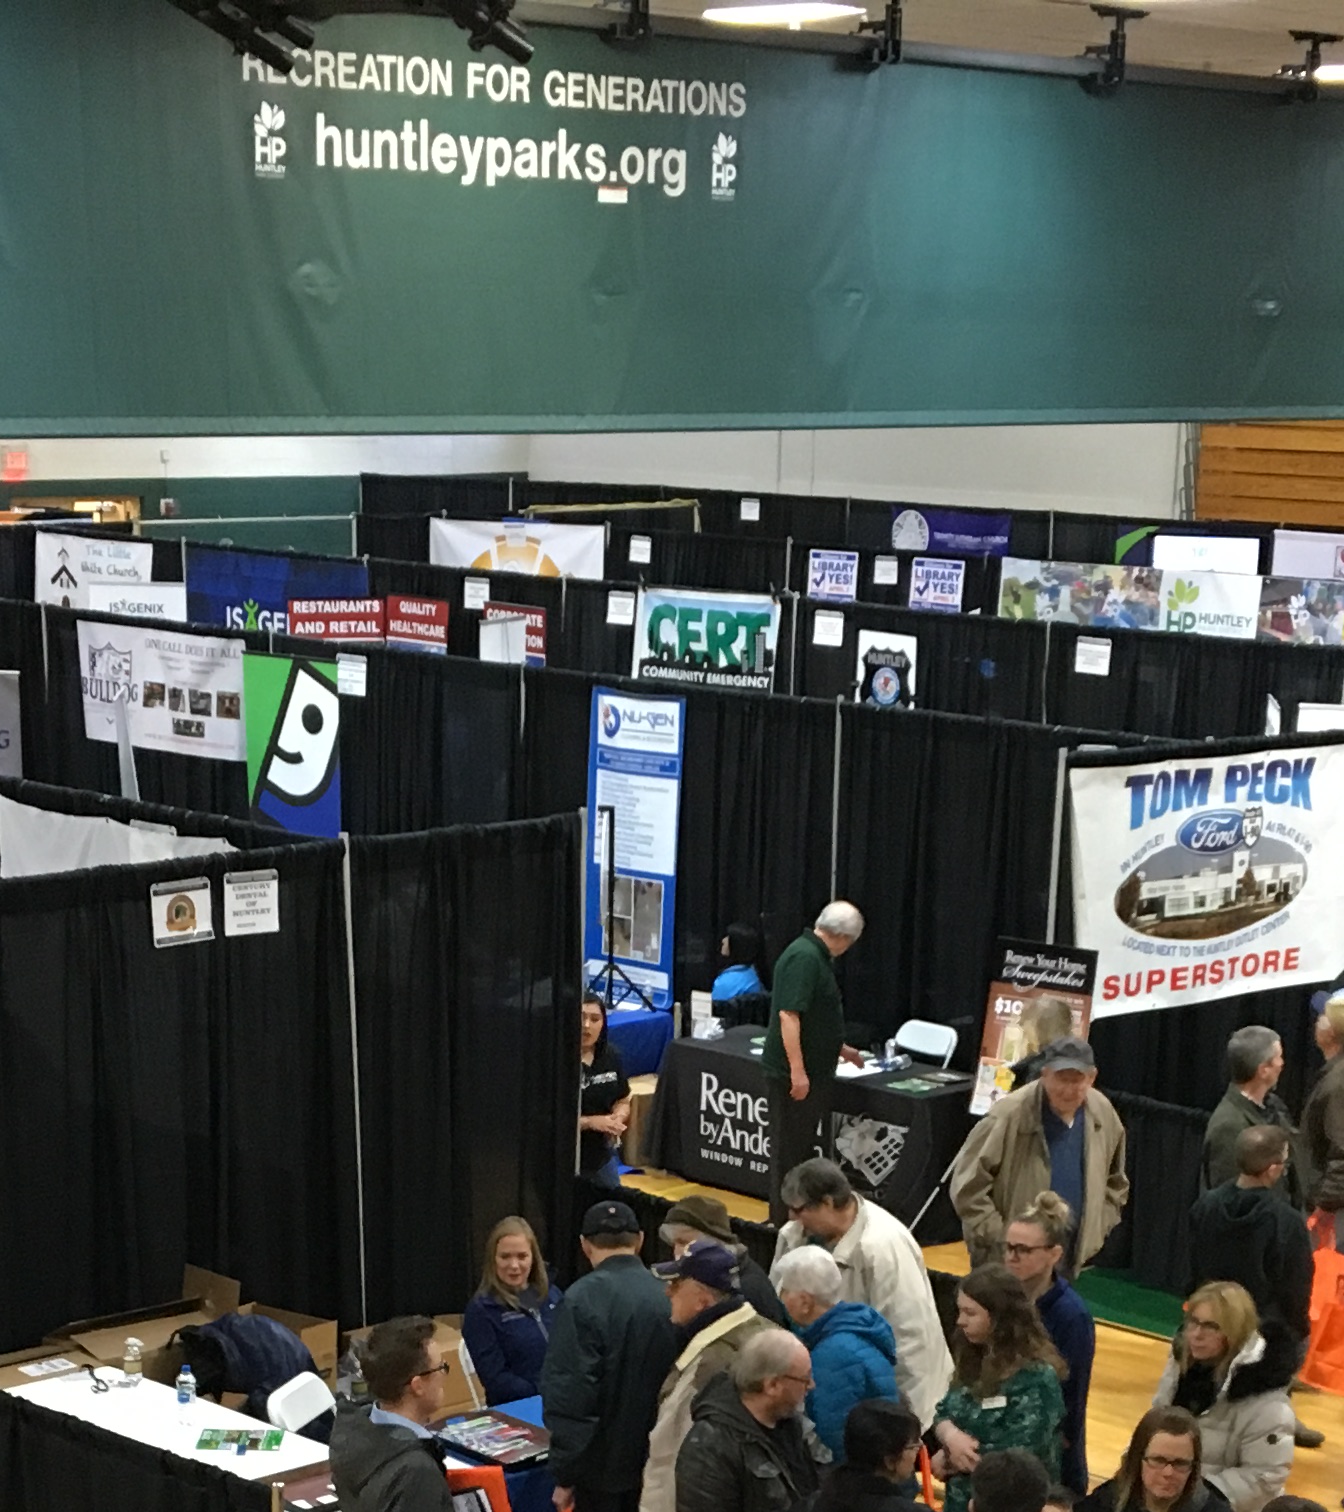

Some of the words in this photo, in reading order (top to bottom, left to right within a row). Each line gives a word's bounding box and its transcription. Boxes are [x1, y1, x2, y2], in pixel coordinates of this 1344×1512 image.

[467, 61, 531, 104] FOR
[543, 69, 747, 118] GENERATIONS
[255, 135, 287, 164] HP
[315, 111, 687, 198] huntleyparks.org
[711, 163, 737, 188] HP
[85, 544, 105, 556] The
[812, 561, 855, 574] LIBRARY
[828, 573, 853, 585] YES!
[914, 567, 961, 582] LIBRARY
[932, 581, 959, 595] YES!
[226, 598, 290, 633] ISAGE
[293, 600, 380, 614] RESTAURANTS
[399, 600, 437, 617] QUALITY
[486, 607, 544, 628] CORPATE
[295, 620, 325, 634] AND
[329, 620, 380, 634] RETAIL
[389, 619, 445, 638] HEALTHCARE
[1166, 610, 1196, 632] HP
[1198, 613, 1253, 629] HUNTLEY
[648, 603, 771, 668] CERT
[641, 664, 704, 684] COMMUNITY
[706, 671, 770, 689] EMERGENCY
[1125, 767, 1214, 831] TOM
[1224, 756, 1317, 811] PECK
[1190, 816, 1238, 850] Ford
[232, 882, 271, 892] CENTURY
[235, 890, 268, 900] DENTAL
[232, 908, 271, 918] HUNTLEY
[1122, 935, 1156, 955] LOCATED
[1156, 944, 1178, 957] NEXT
[1179, 945, 1191, 957] TO
[1005, 949, 1035, 965] Renew
[1037, 954, 1056, 968] Your
[1058, 956, 1088, 973] Home
[1002, 963, 1086, 989] Sweepstakes
[1102, 946, 1301, 1001] SUPERSTORE
[700, 1071, 770, 1127] Rene
[716, 1117, 771, 1158] Ande
[700, 1147, 744, 1168] WINDOW
[749, 1160, 769, 1174] REP
